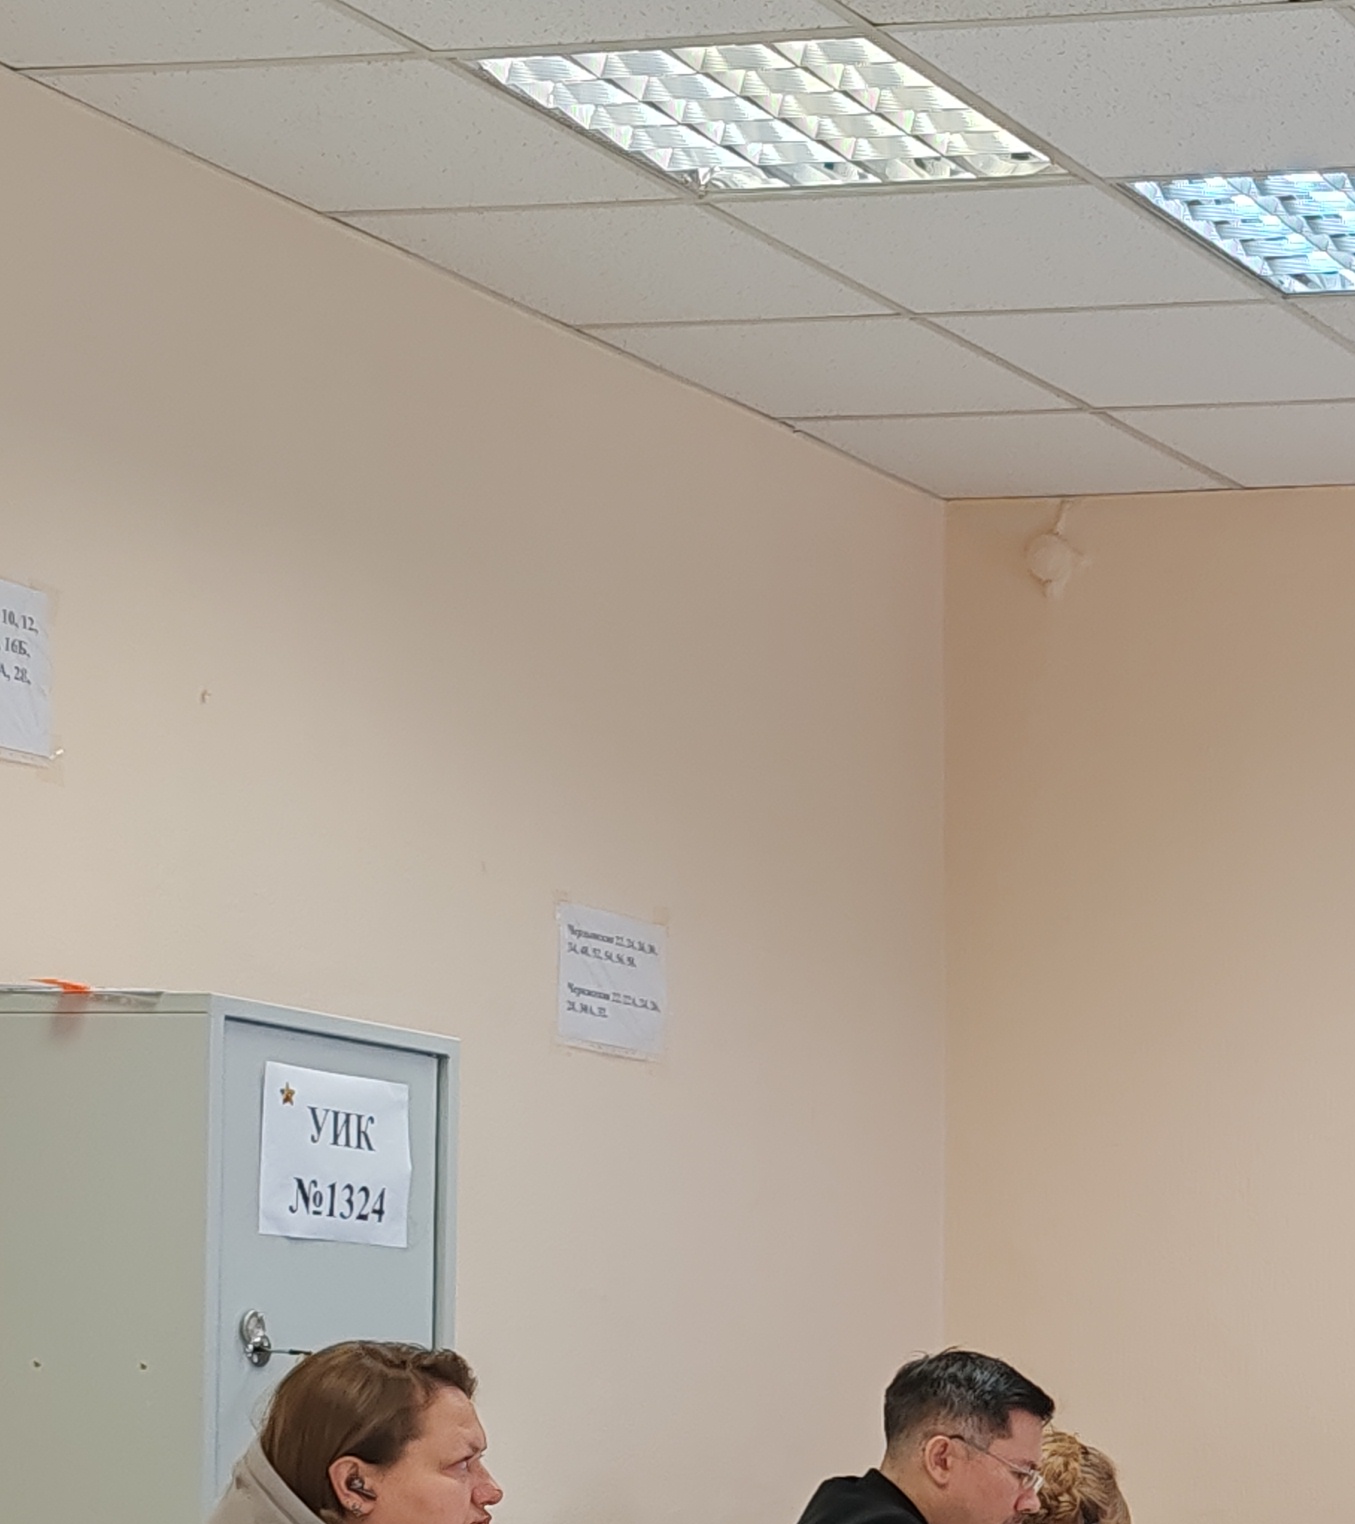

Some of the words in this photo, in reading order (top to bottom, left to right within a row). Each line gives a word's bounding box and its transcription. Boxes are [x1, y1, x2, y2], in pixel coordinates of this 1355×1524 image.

[2, 608, 19, 629] 10,
[21, 614, 39, 635] 12,
[307, 1106, 376, 1151] УИК
[288, 1177, 387, 1223] №1324
